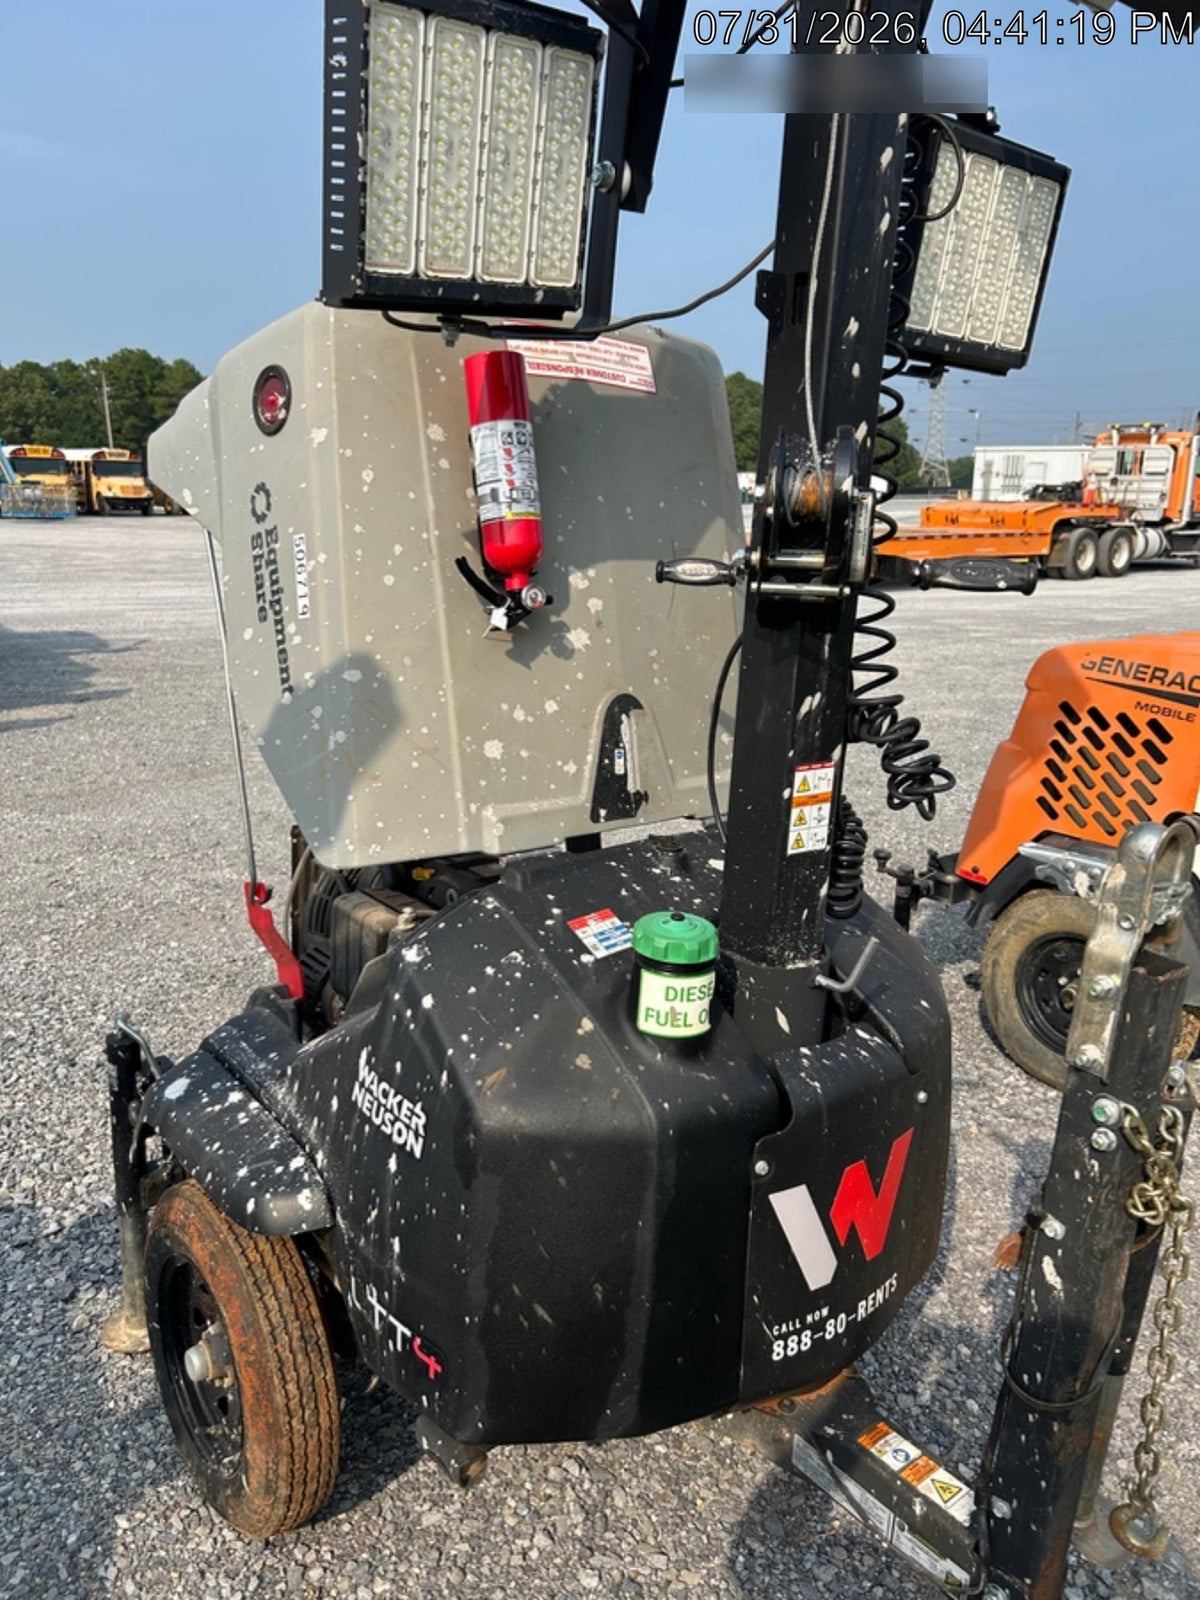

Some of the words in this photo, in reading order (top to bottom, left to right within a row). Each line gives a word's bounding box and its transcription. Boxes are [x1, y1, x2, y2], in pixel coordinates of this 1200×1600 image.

[251, 531, 268, 624] Share
[265, 524, 295, 696] Equipment
[1134, 700, 1197, 724] MOBILE
[645, 1006, 694, 1029] FUEL
[351, 1080, 424, 1159] NEUSON
[358, 1058, 427, 1137] WACKER
[771, 1271, 899, 1362] 888-80-RENTS
[772, 1318, 802, 1337] CALL
[806, 1305, 830, 1326] NOW
